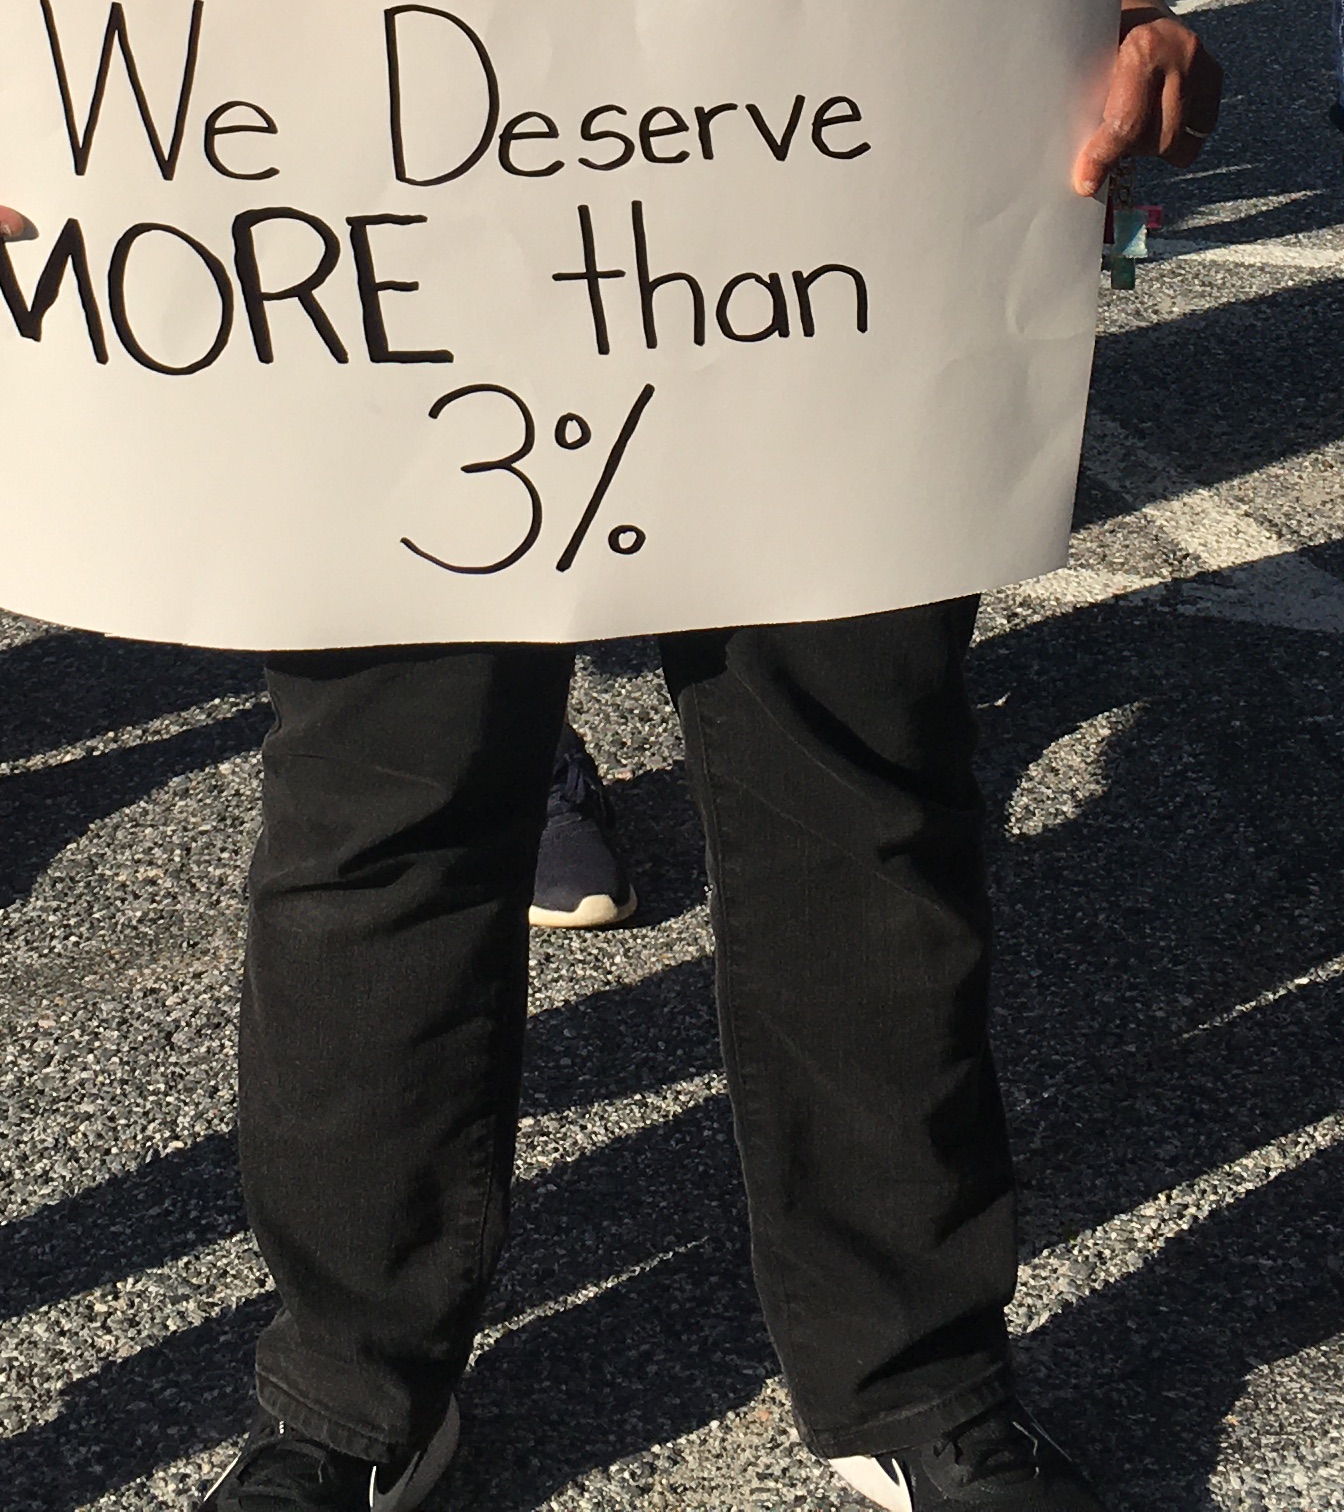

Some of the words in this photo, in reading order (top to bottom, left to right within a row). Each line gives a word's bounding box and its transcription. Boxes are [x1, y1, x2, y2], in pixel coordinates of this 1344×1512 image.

[384, 5, 871, 186] Deserve
[552, 201, 867, 355] than
[401, 384, 654, 574] 3%
